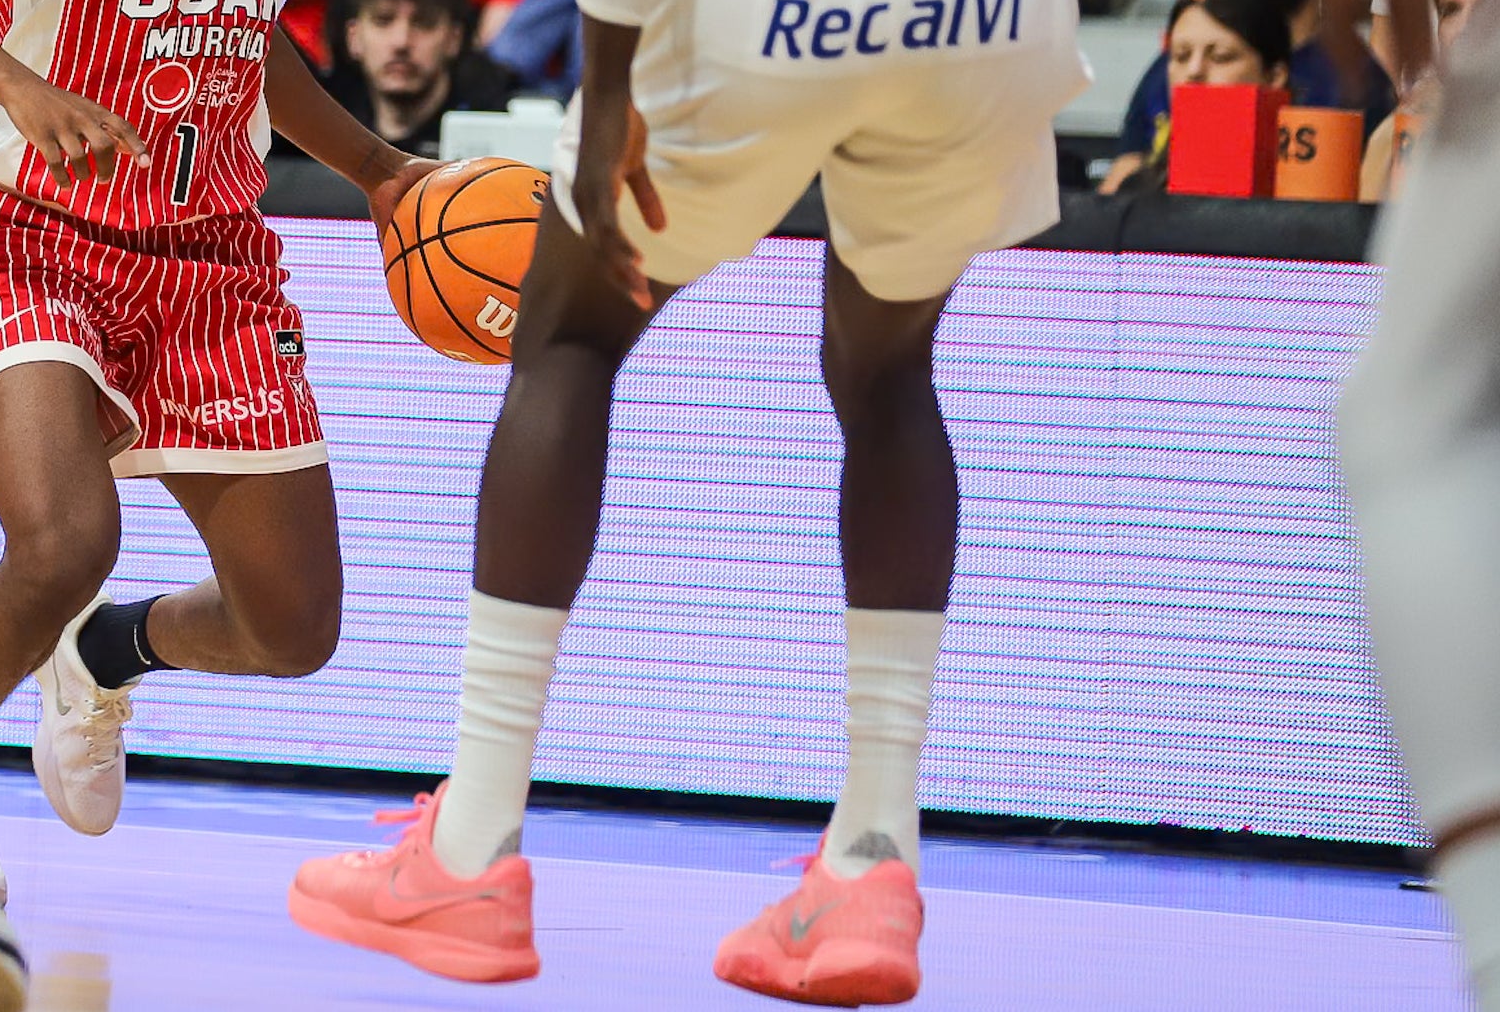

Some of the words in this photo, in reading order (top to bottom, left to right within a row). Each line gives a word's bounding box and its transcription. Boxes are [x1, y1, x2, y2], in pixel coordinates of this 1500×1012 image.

[144, 25, 267, 64] MURCIA
[170, 122, 199, 206] 1
[278, 340, 297, 354] acb
[159, 386, 284, 426] INVERSUS
